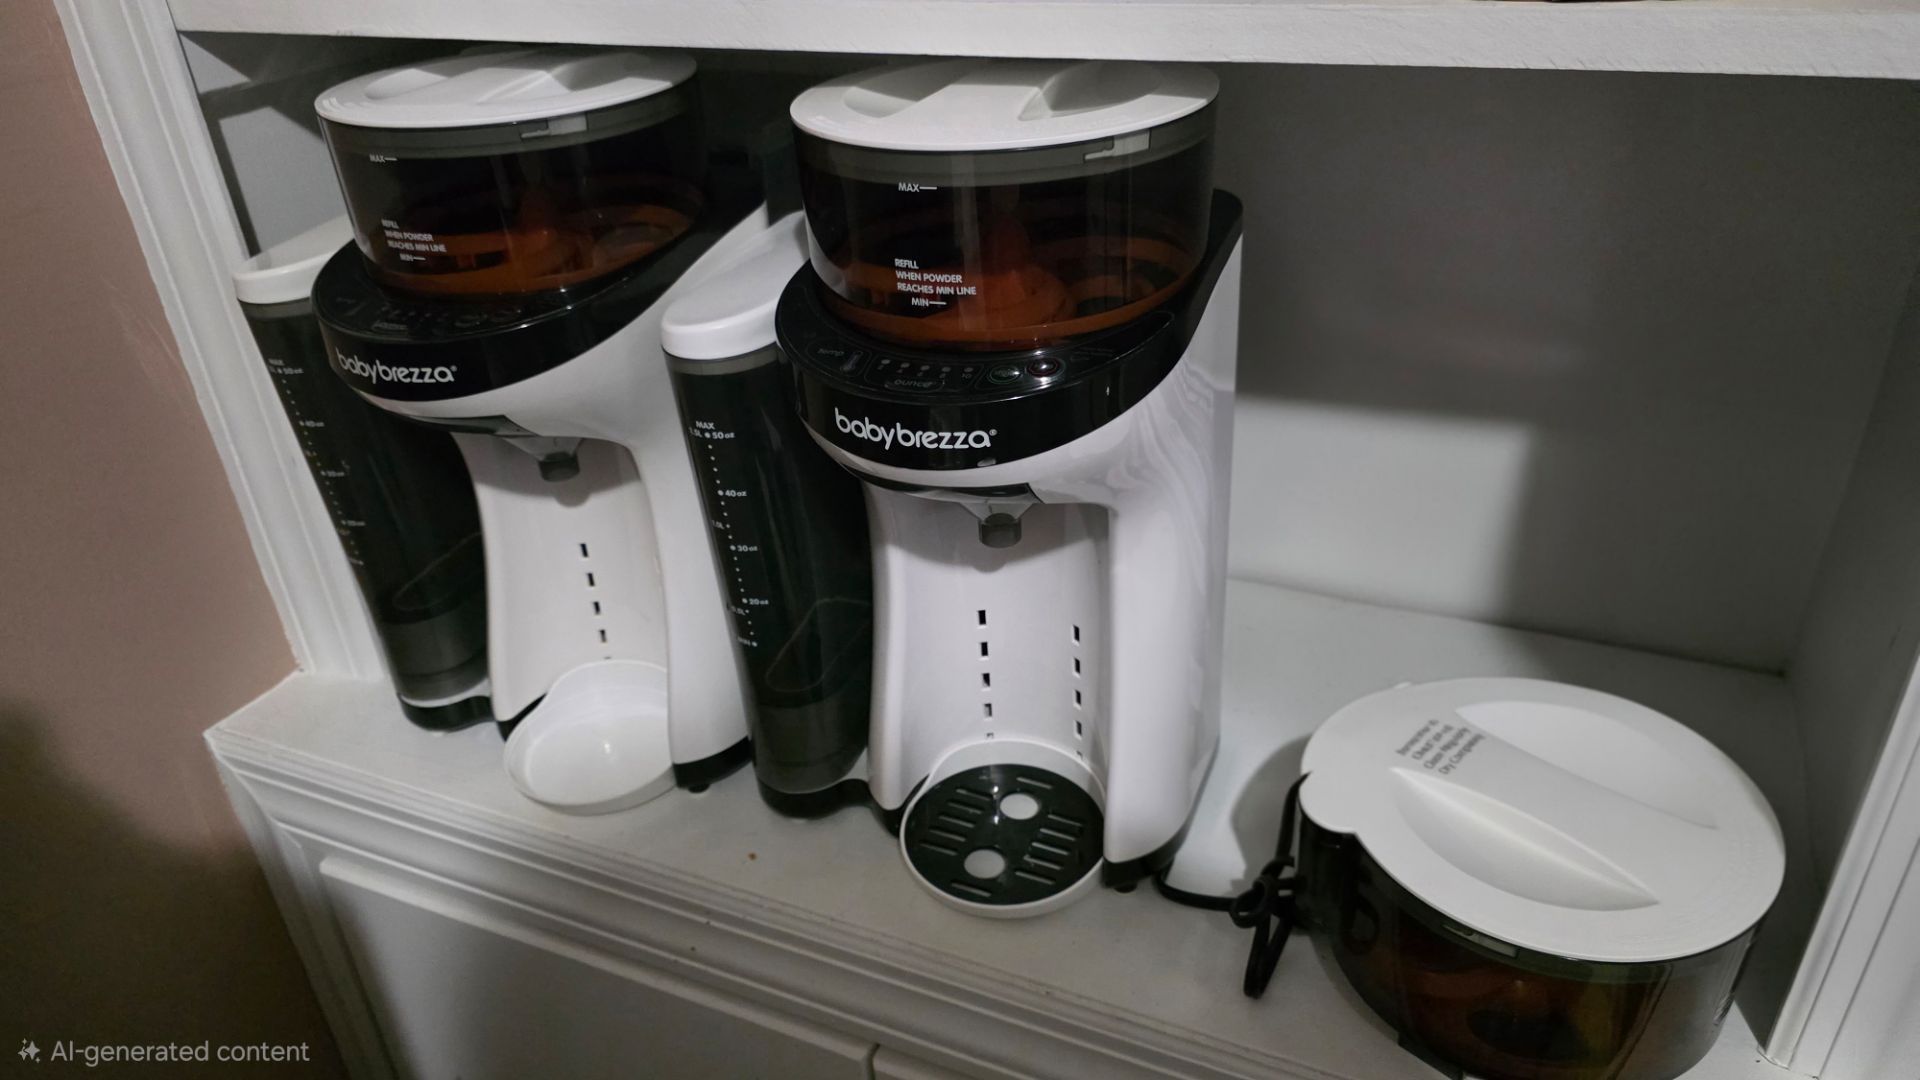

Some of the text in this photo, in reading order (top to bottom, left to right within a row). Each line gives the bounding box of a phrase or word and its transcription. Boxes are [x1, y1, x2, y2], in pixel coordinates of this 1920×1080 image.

[898, 182, 920, 193] MAX
[403, 232, 434, 242] POWDER
[894, 258, 919, 270] REFILL
[895, 270, 963, 284] WHEN POWDER
[896, 282, 977, 296] REACHES MIN LINE
[911, 297, 930, 307] MIN
[695, 420, 716, 430] MAX
